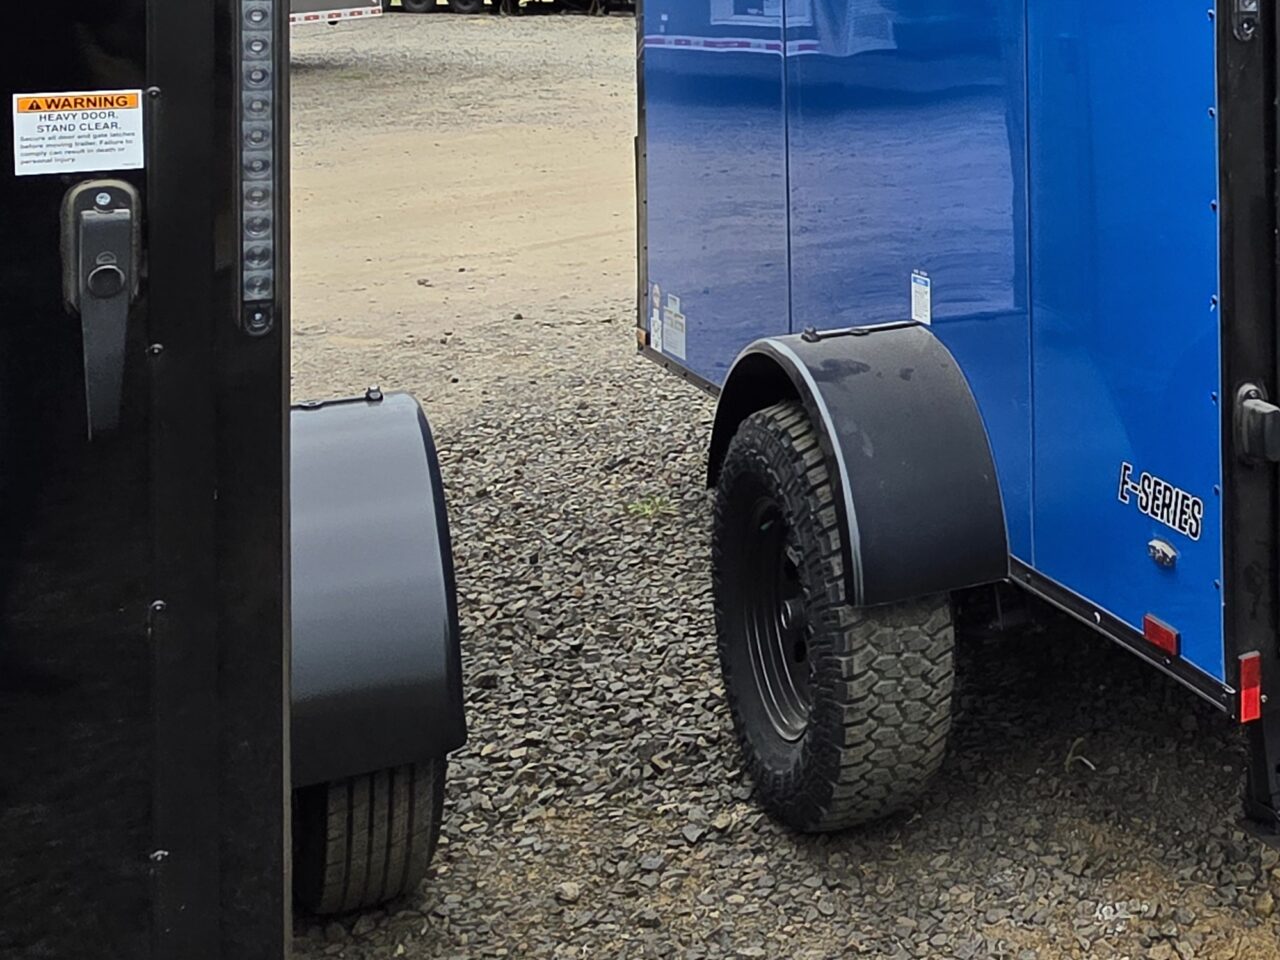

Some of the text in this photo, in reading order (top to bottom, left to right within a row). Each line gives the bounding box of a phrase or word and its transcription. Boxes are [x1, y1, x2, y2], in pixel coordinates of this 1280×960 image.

[44, 96, 128, 109] WARNING
[39, 113, 78, 122] HEAVY
[37, 123, 76, 133] STAND
[1118, 461, 1203, 541] E-SERIES
